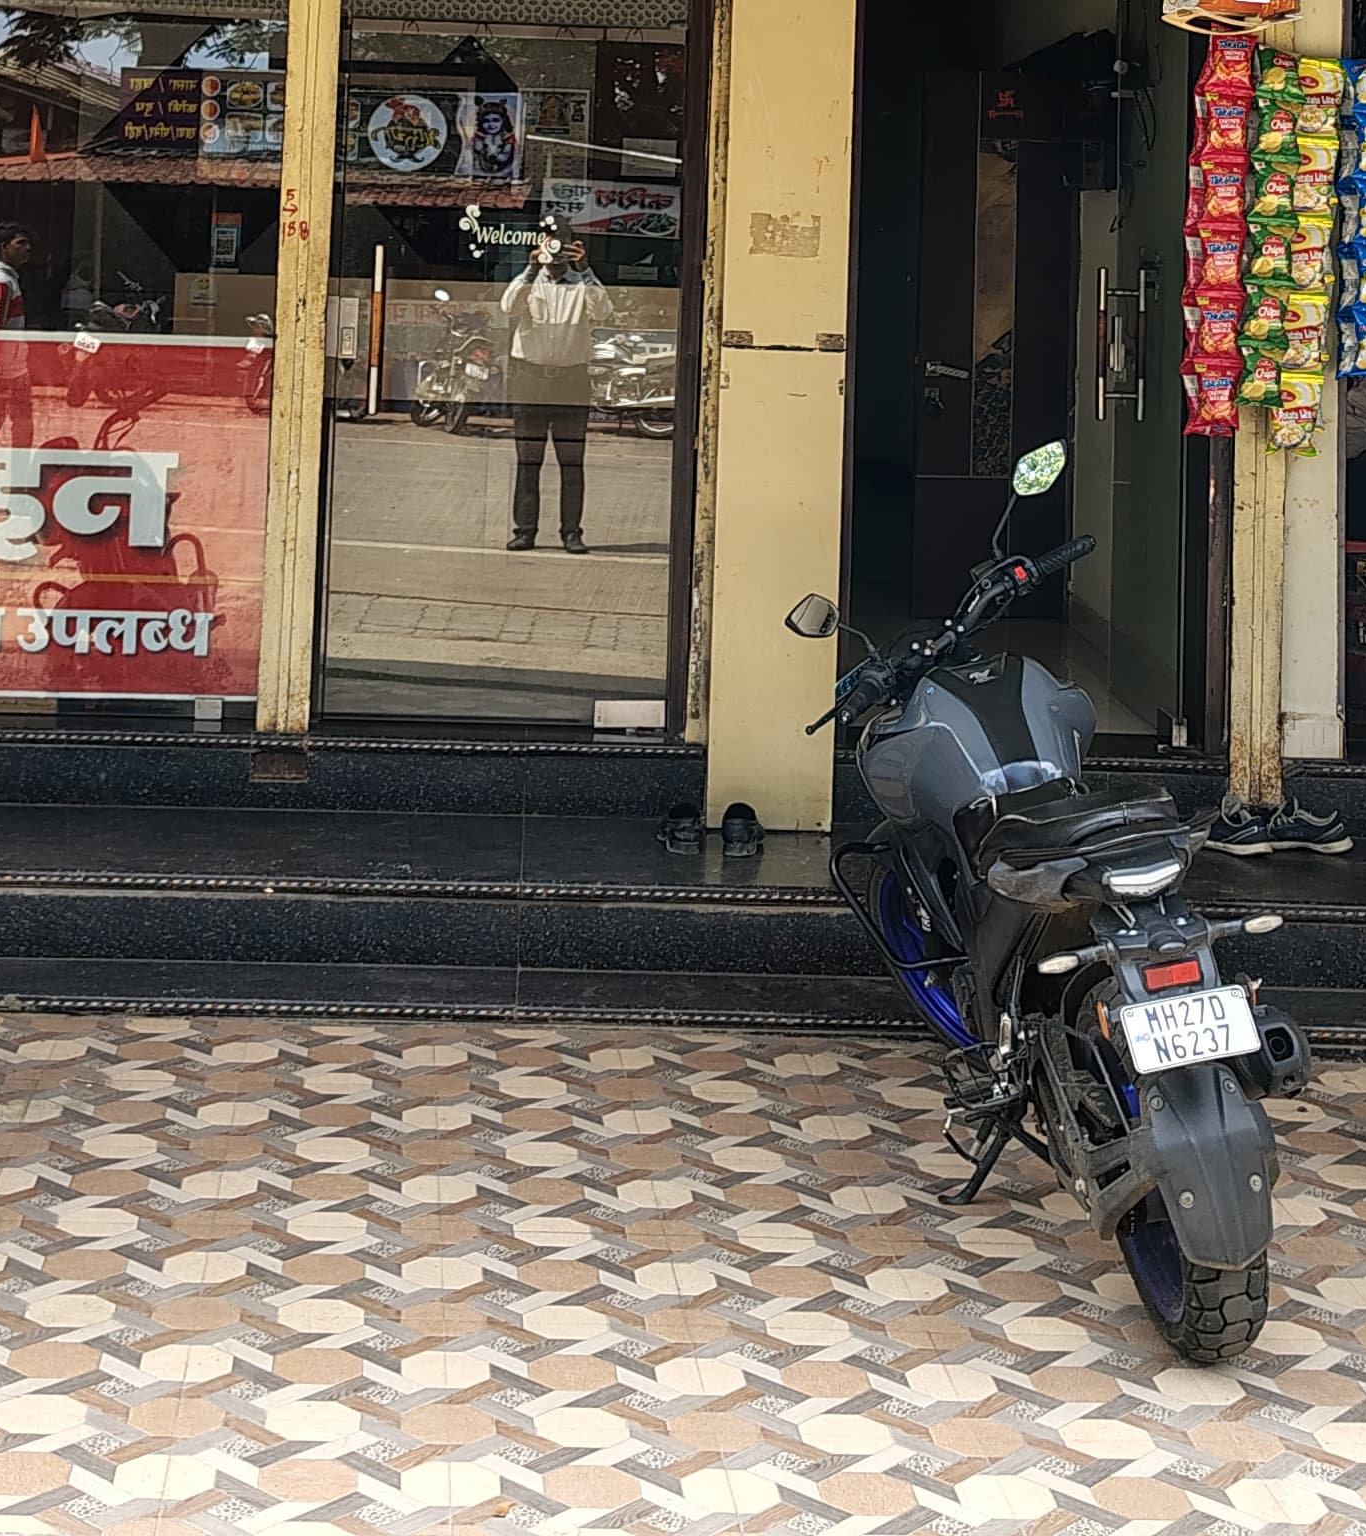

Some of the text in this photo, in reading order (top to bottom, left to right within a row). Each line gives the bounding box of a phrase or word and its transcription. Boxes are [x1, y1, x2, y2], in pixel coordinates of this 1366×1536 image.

[475, 225, 547, 249] Welcome
[18, 607, 215, 658] उपलब्ध
[1145, 994, 1226, 1034] MH27D
[1156, 1024, 1231, 1064] N6237
